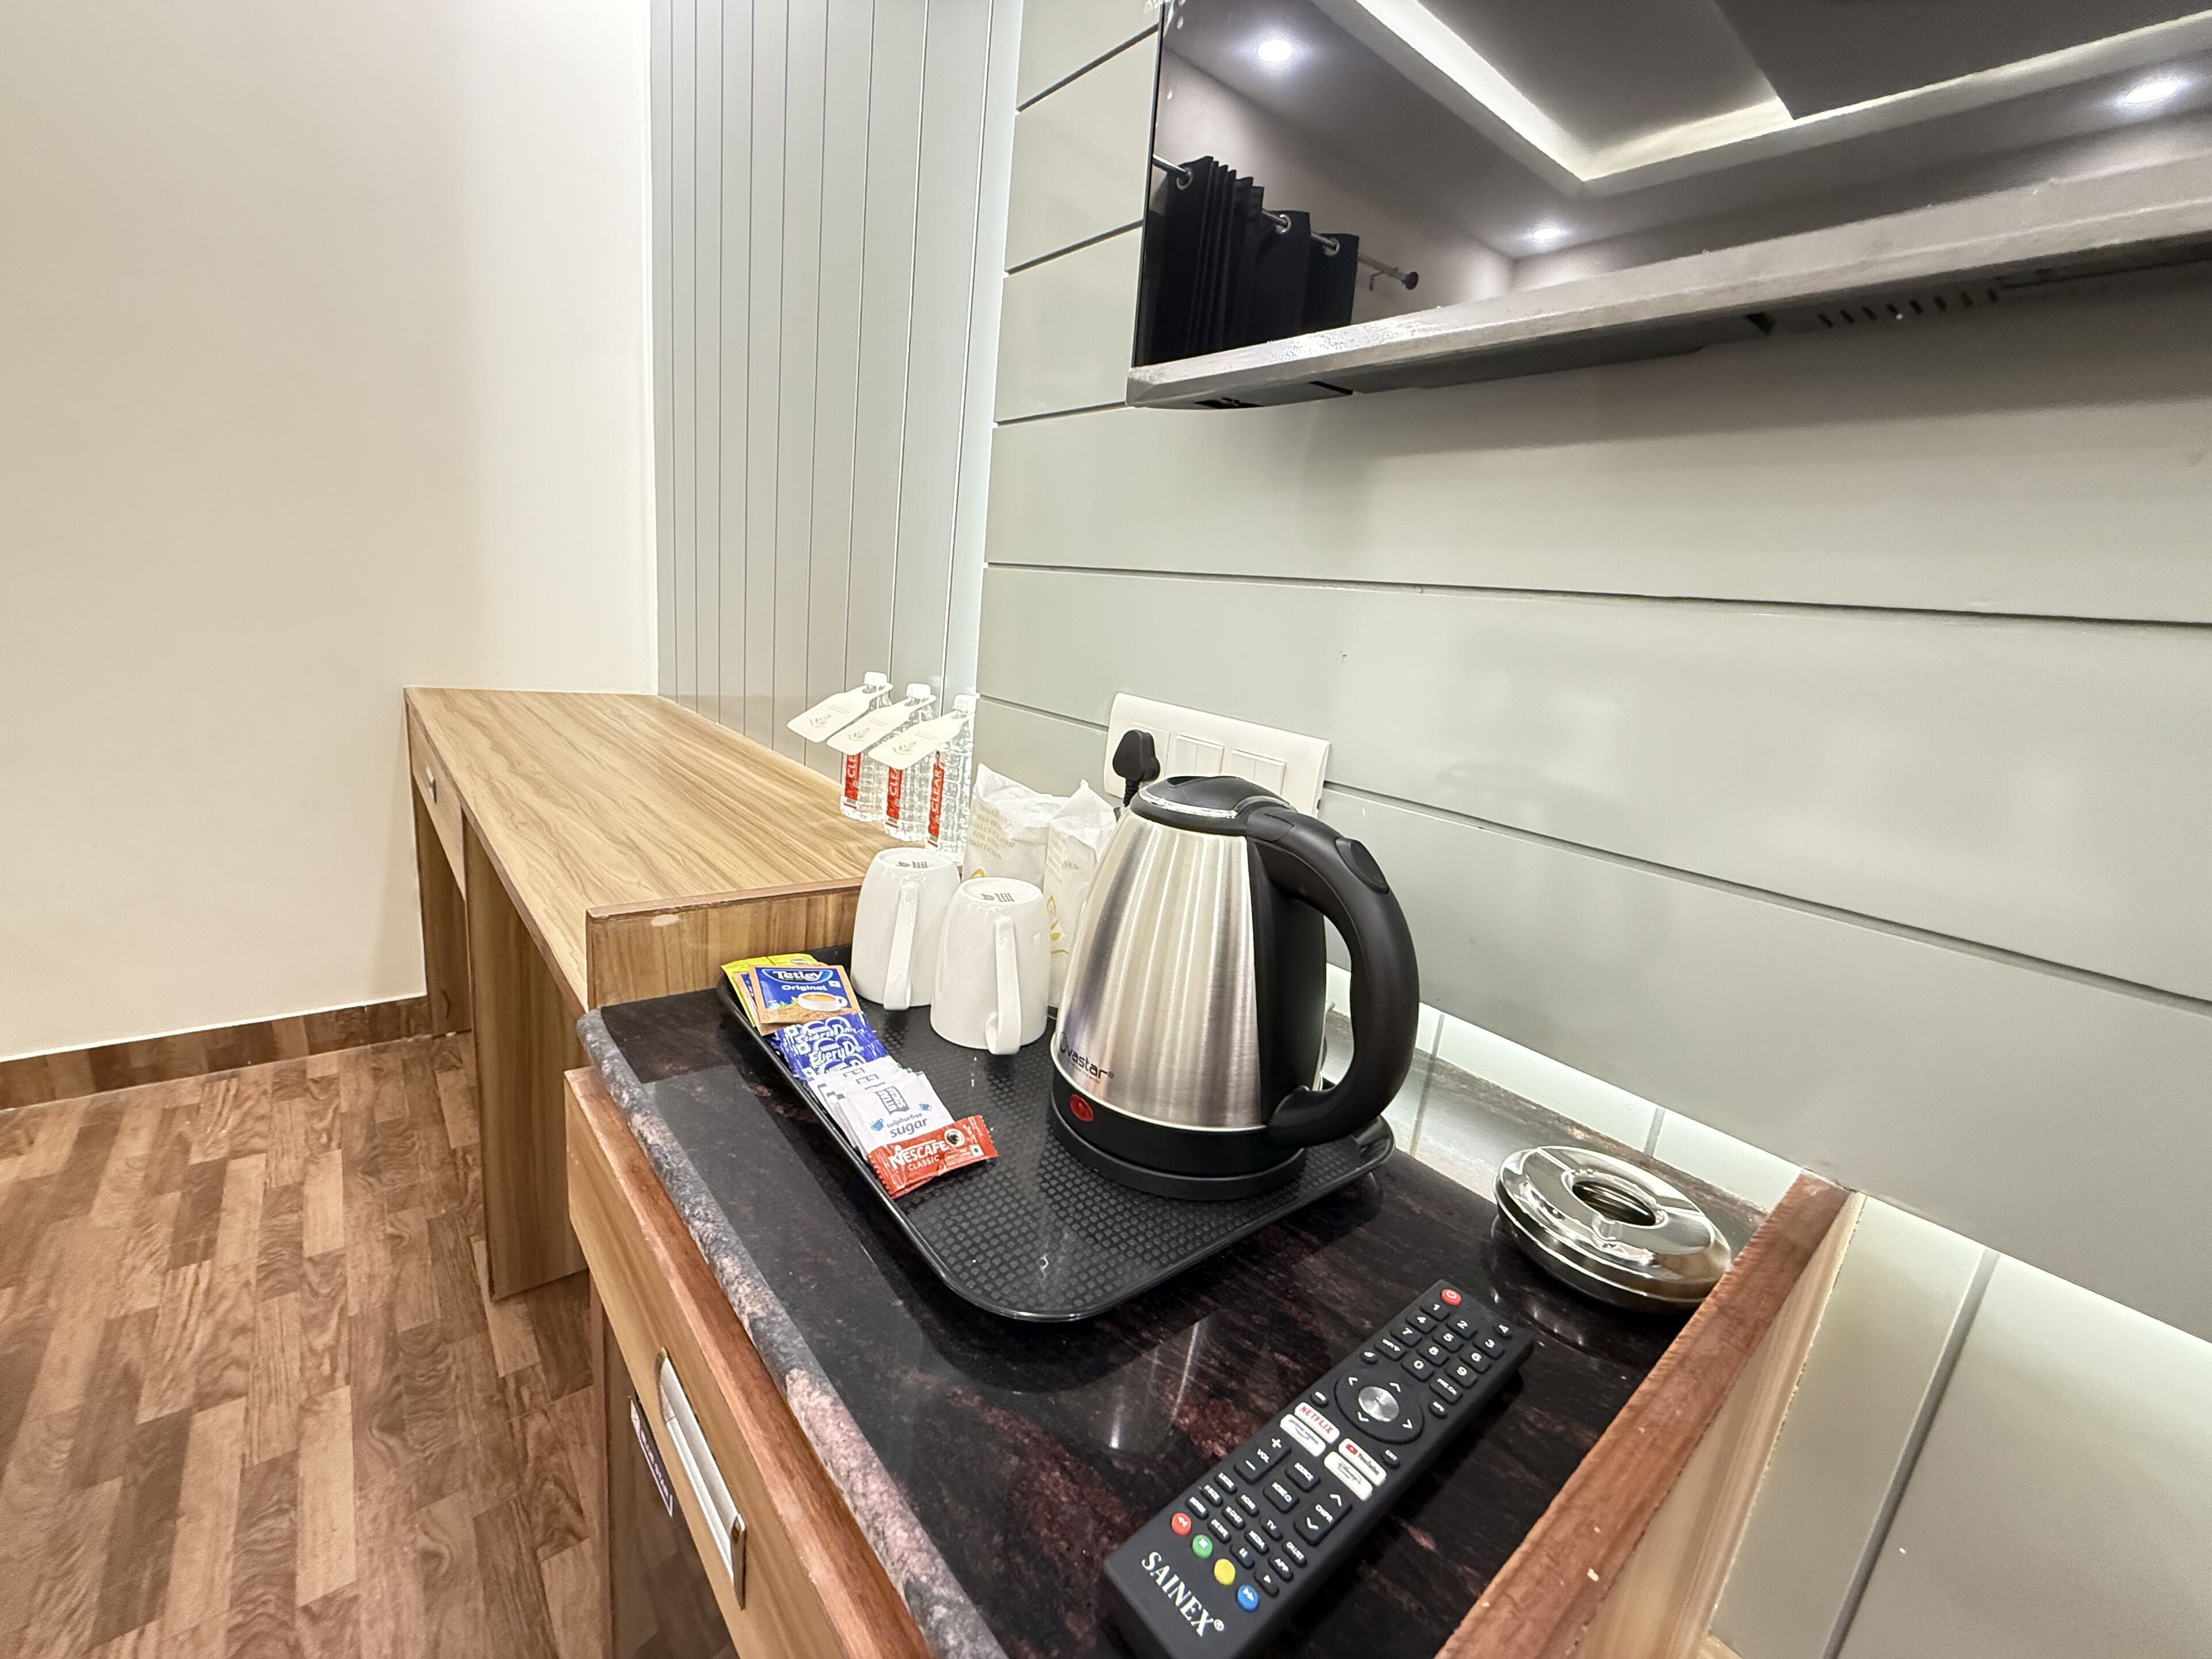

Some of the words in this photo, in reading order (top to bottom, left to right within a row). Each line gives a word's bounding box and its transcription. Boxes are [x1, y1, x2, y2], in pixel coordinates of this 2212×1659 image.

[847, 754, 856, 778] CLE
[889, 768, 899, 796] CLE
[931, 769, 942, 812] CLEAR
[772, 971, 823, 982] Tetley
[887, 1112, 923, 1129] sulphurfree
[889, 1118, 928, 1138] sugar
[908, 1154, 941, 1171] CLASSIC
[1457, 1320, 1468, 1330] 2
[1444, 1333, 1455, 1342] 5
[1485, 1339, 1495, 1349] 3
[1429, 1347, 1439, 1355] 8
[1471, 1353, 1482, 1362] 6
[1414, 1361, 1425, 1370] 0
[1457, 1367, 1468, 1376] 9
[1300, 1406, 1334, 1434] NETFLIX
[1257, 1449, 1270, 1464] VOL
[1357, 1452, 1380, 1476] YouTube
[1267, 1520, 1277, 1530] TV
[1275, 1559, 1289, 1571] APP
